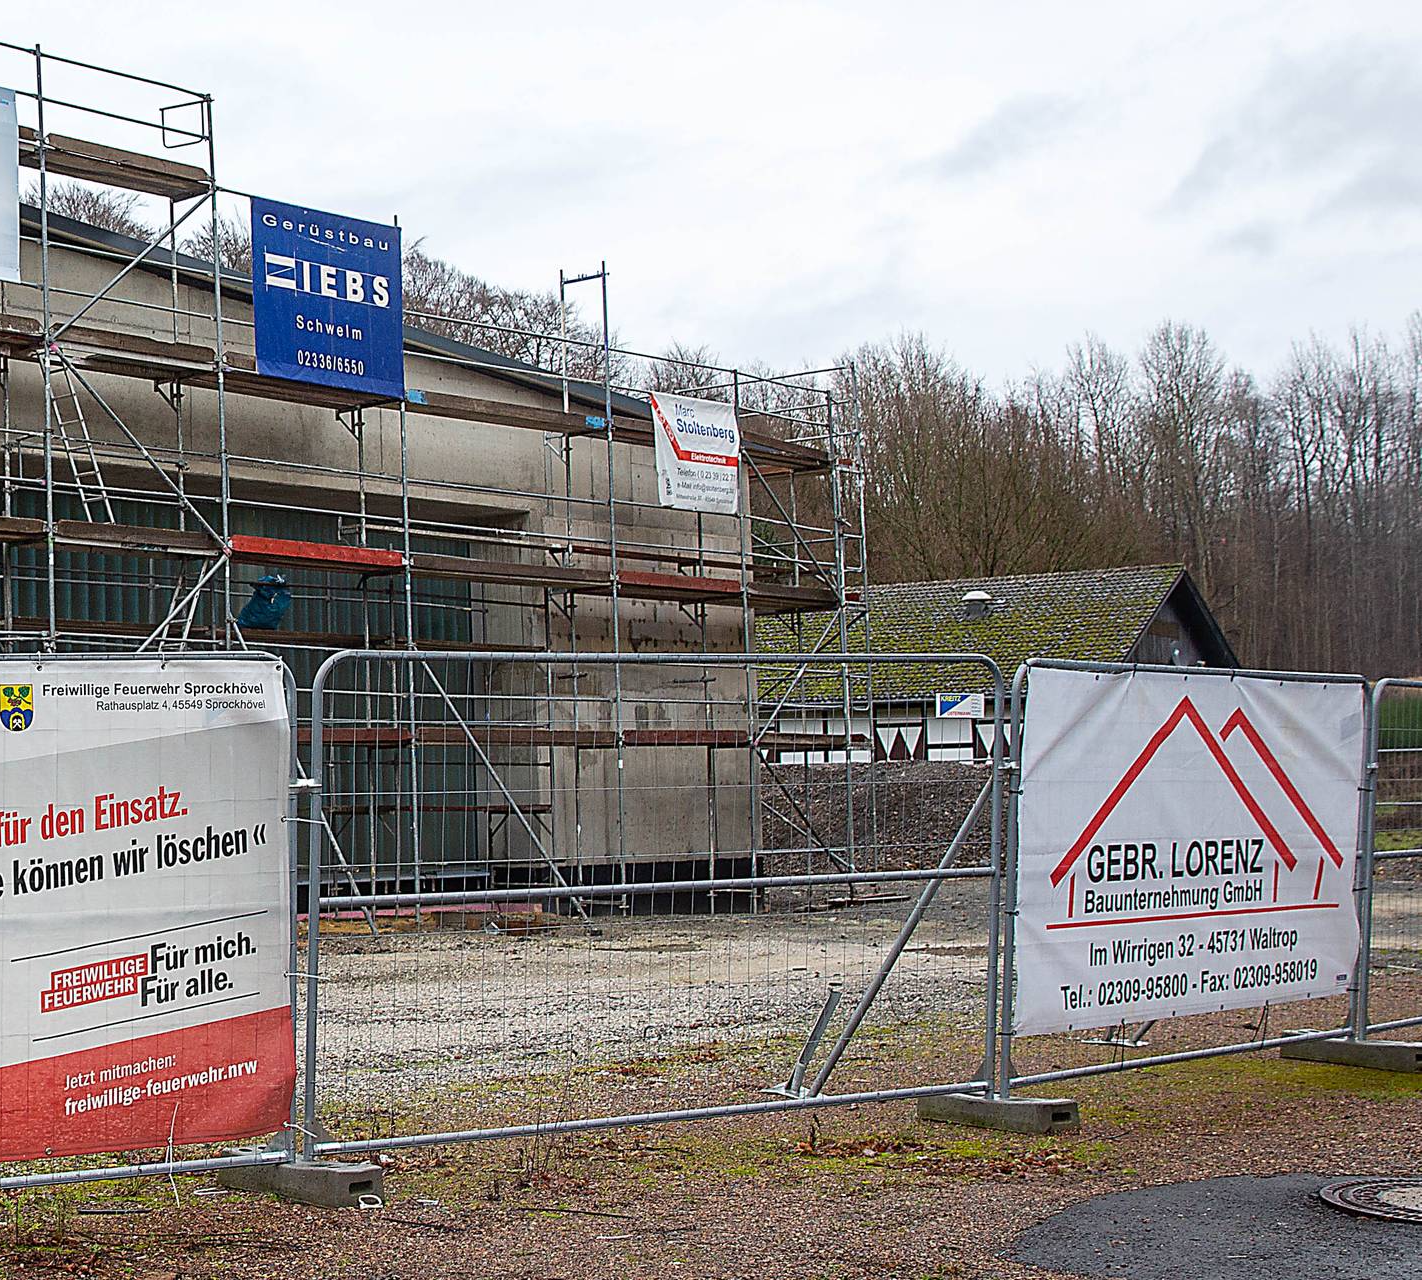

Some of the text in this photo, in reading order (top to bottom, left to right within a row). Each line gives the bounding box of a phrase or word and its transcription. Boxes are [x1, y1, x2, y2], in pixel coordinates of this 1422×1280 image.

[262, 213, 389, 251] Gerüstbau
[296, 314, 363, 341] Schwelm
[297, 349, 364, 376] 02336/6550
[675, 404, 695, 418] Marc
[676, 418, 735, 444] Stoltenberg
[677, 466, 696, 478] Telefon
[42, 682, 264, 698] Freiwillige Feuerwehr Sprockhövel
[96, 700, 159, 712] Rathausplatz
[205, 699, 266, 711] Sprockhövel
[41, 803, 85, 841] den
[94, 785, 188, 832] Einsatz.
[13, 853, 104, 896] können
[112, 838, 149, 878] wir
[156, 825, 248, 870] löschen
[1086, 838, 1264, 884] GEBR. LORENZ
[1084, 878, 1263, 914] Bauunternehmung GmbH
[150, 931, 257, 975] Für mich.
[1089, 942, 1108, 967] Im
[1112, 937, 1174, 967] Wirrigen
[1178, 933, 1195, 958] 32
[1207, 928, 1246, 954] 45731
[1249, 926, 1298, 952] Waltrop
[53, 957, 145, 990] FREIWILLIGE
[140, 968, 234, 1007] Für alle.
[1060, 983, 1092, 1011] Tel.:
[1098, 972, 1188, 1007] 02309-95800
[1201, 969, 1230, 994] Fax:
[1233, 958, 1318, 990] 02309-958019
[43, 977, 135, 1010] FEUERWEHR
[64, 1053, 177, 1091] Jetzt mitmachen:
[64, 1058, 258, 1116] freiwillige-feuerwehr.nrw
